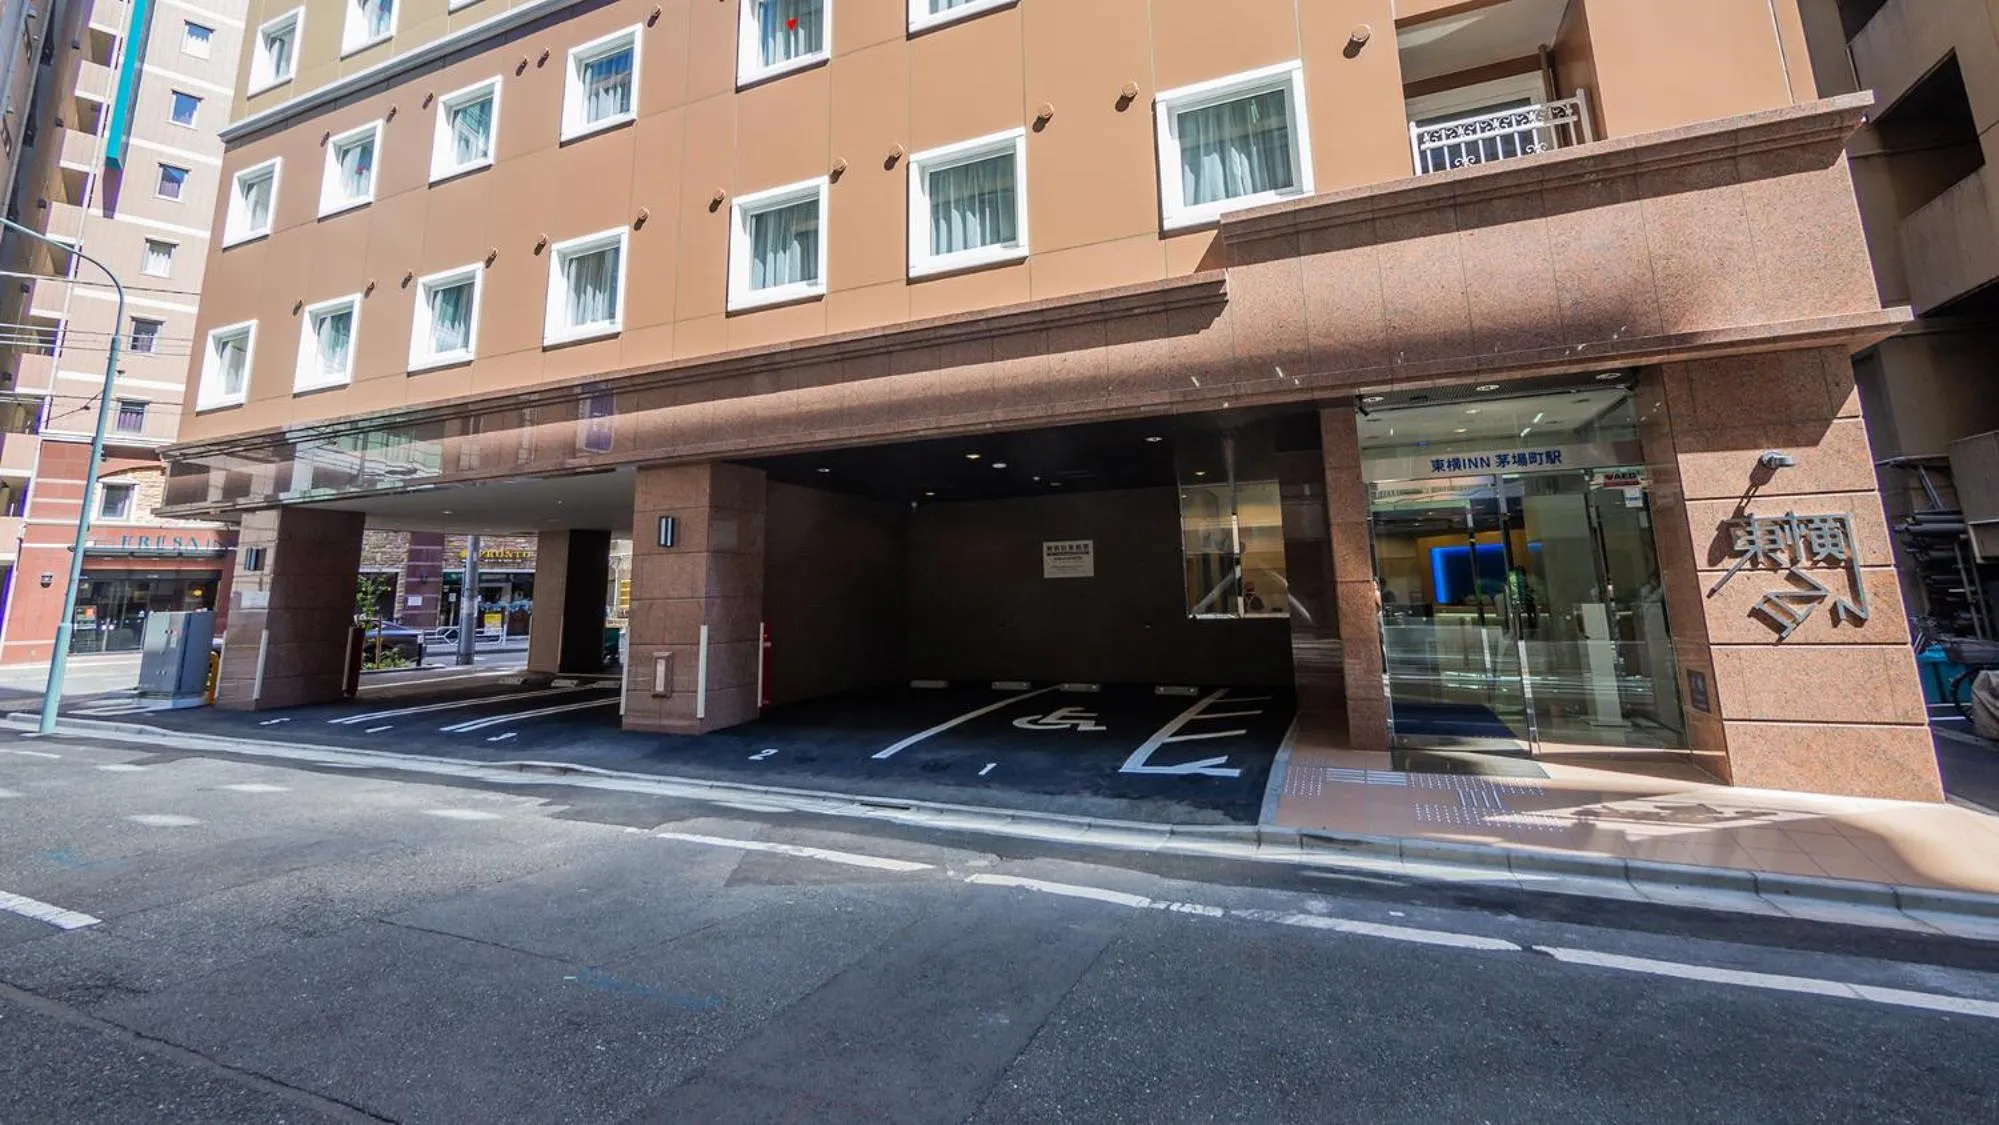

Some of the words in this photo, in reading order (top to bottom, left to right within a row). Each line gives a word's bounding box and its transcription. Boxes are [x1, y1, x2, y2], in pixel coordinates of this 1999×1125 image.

[1431, 456, 1491, 473] 東横INN
[1495, 450, 1563, 469] 茅場町駅
[748, 748, 780, 761] 2
[977, 762, 998, 777] 1
